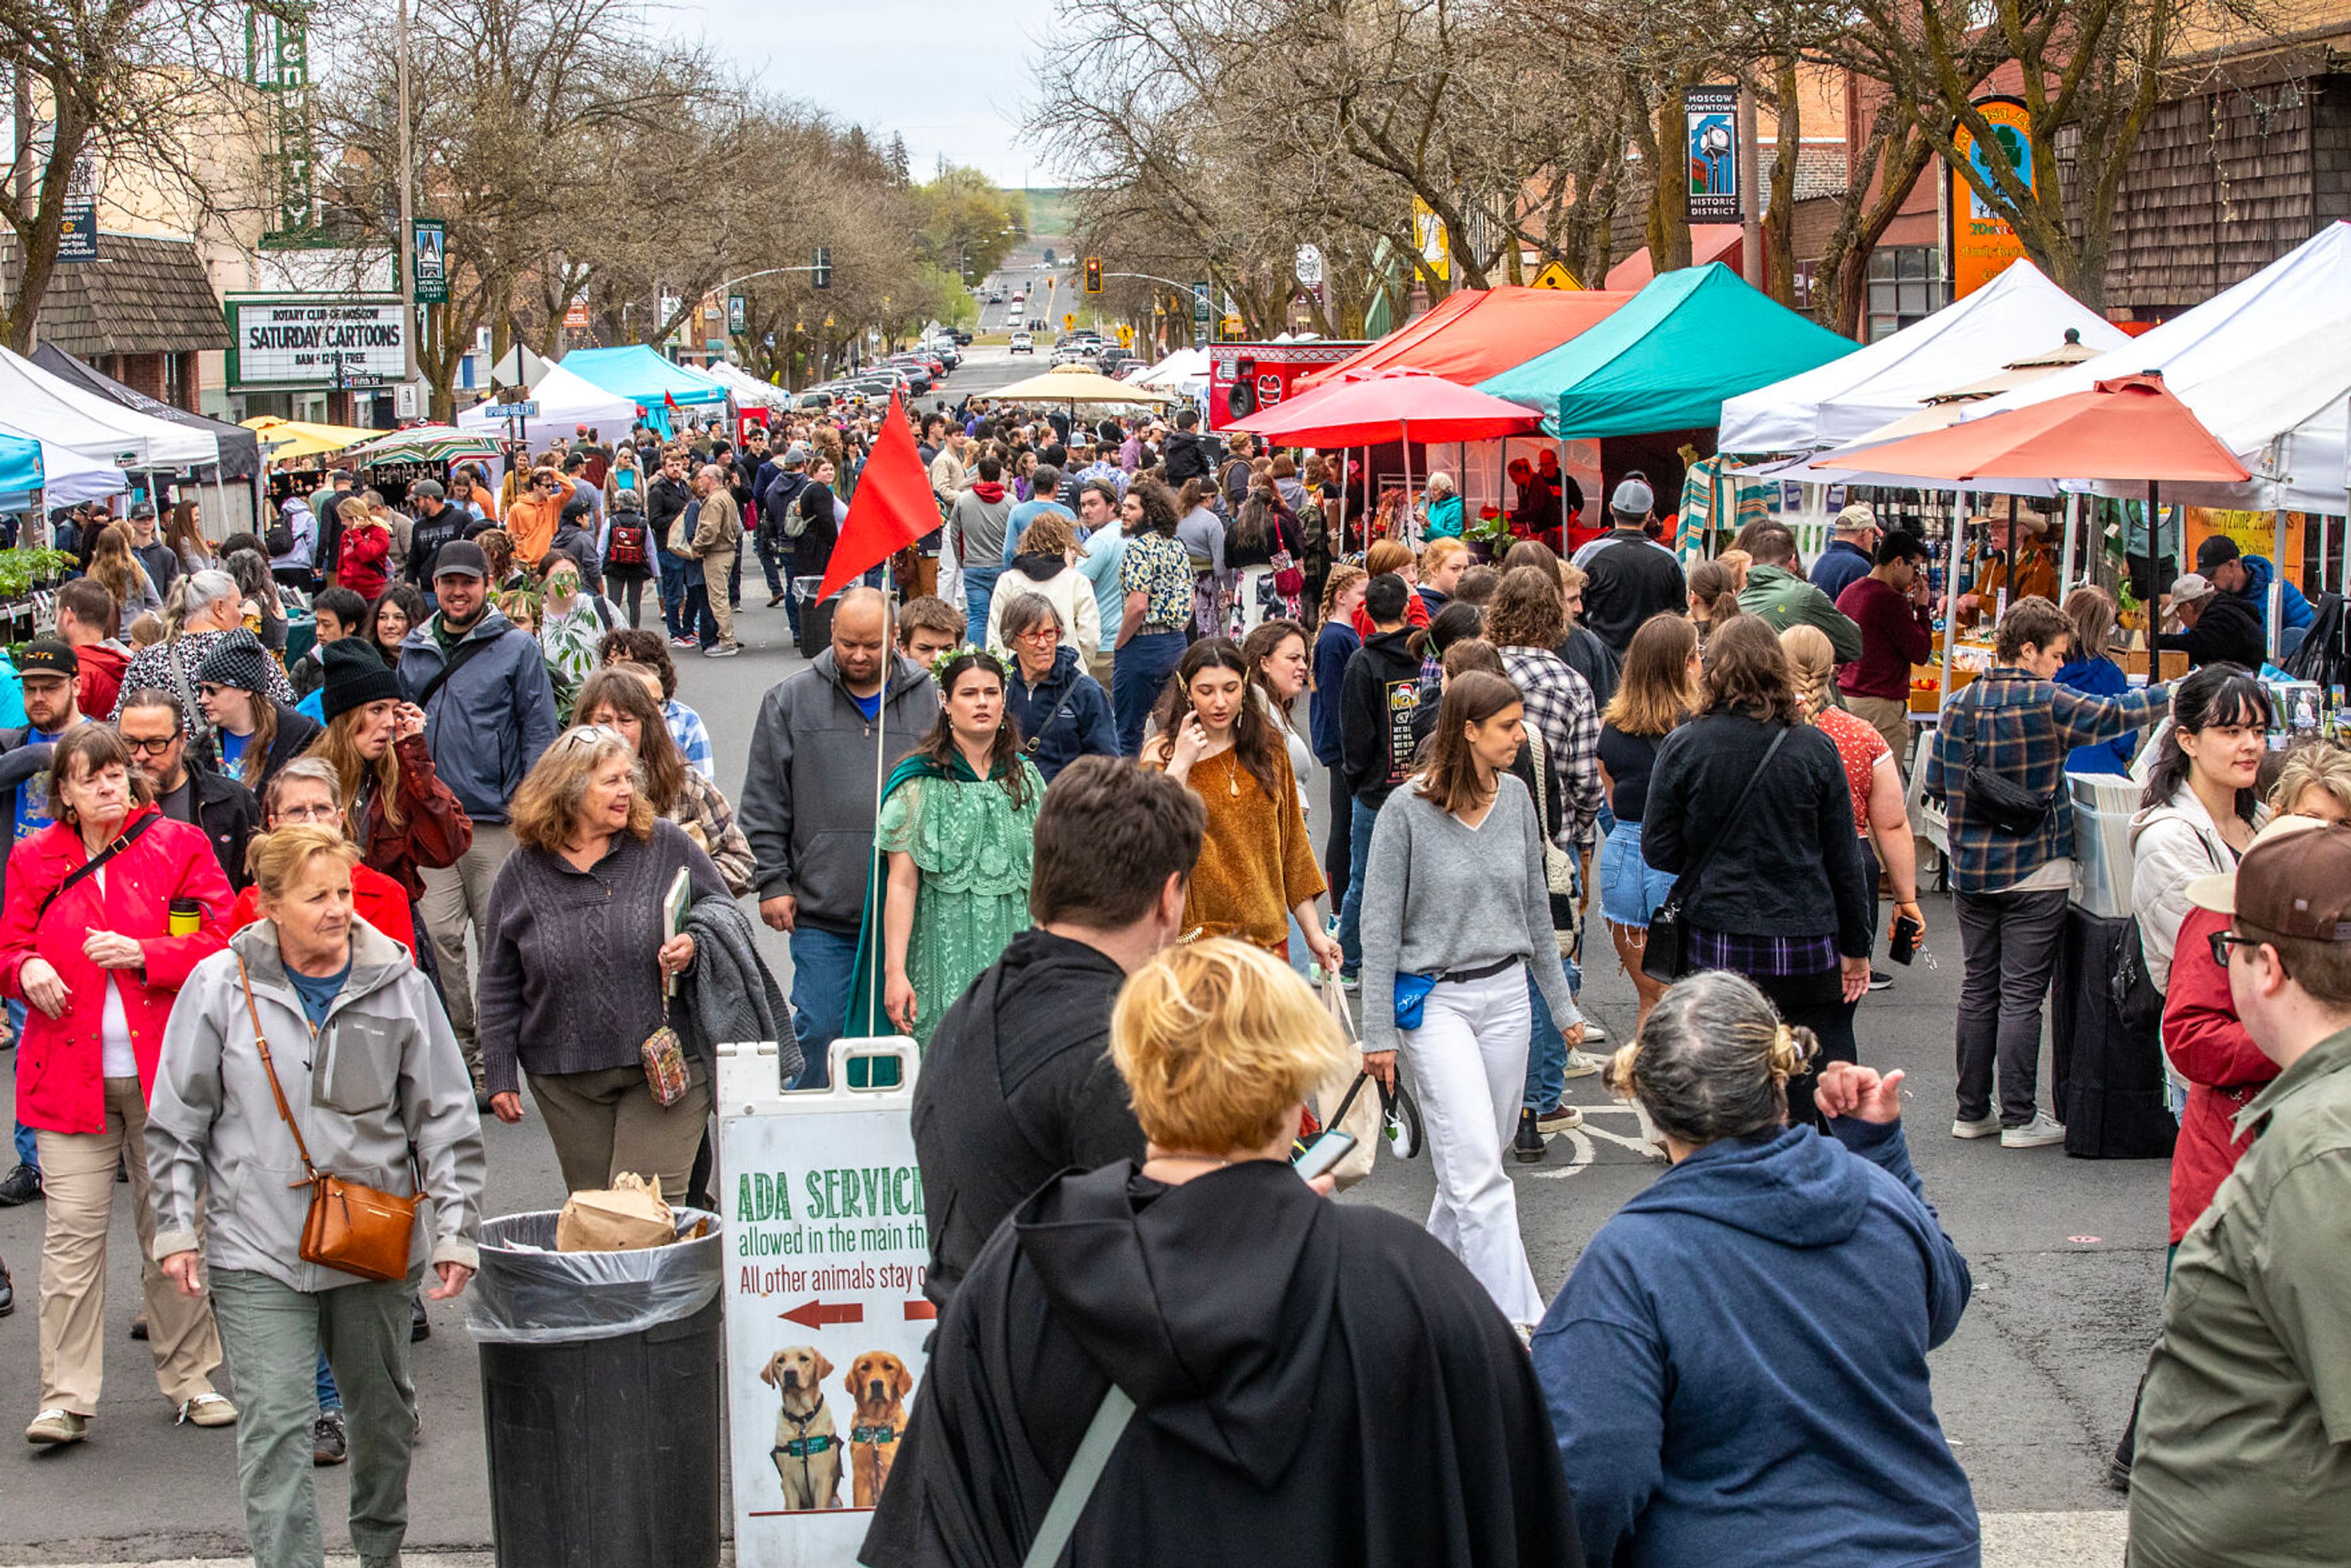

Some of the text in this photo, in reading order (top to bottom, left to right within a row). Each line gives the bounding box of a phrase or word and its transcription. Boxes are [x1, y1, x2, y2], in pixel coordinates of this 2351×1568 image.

[1688, 94, 1733, 103] MOSCOW
[1690, 197, 1736, 206] HISTORIC
[1690, 207, 1736, 216] DISTRICT
[273, 308, 380, 321] ROTARY CLUB OF MOSCOW
[249, 324, 400, 350] SATURDAY CARTOONS
[295, 353, 314, 365] 8AM
[345, 353, 367, 364] FREE
[354, 377, 380, 387] Fifth St
[737, 1171, 792, 1223] ADA
[739, 1219, 928, 1256] allowed in the main th
[740, 1260, 928, 1294] All other animals stay o
